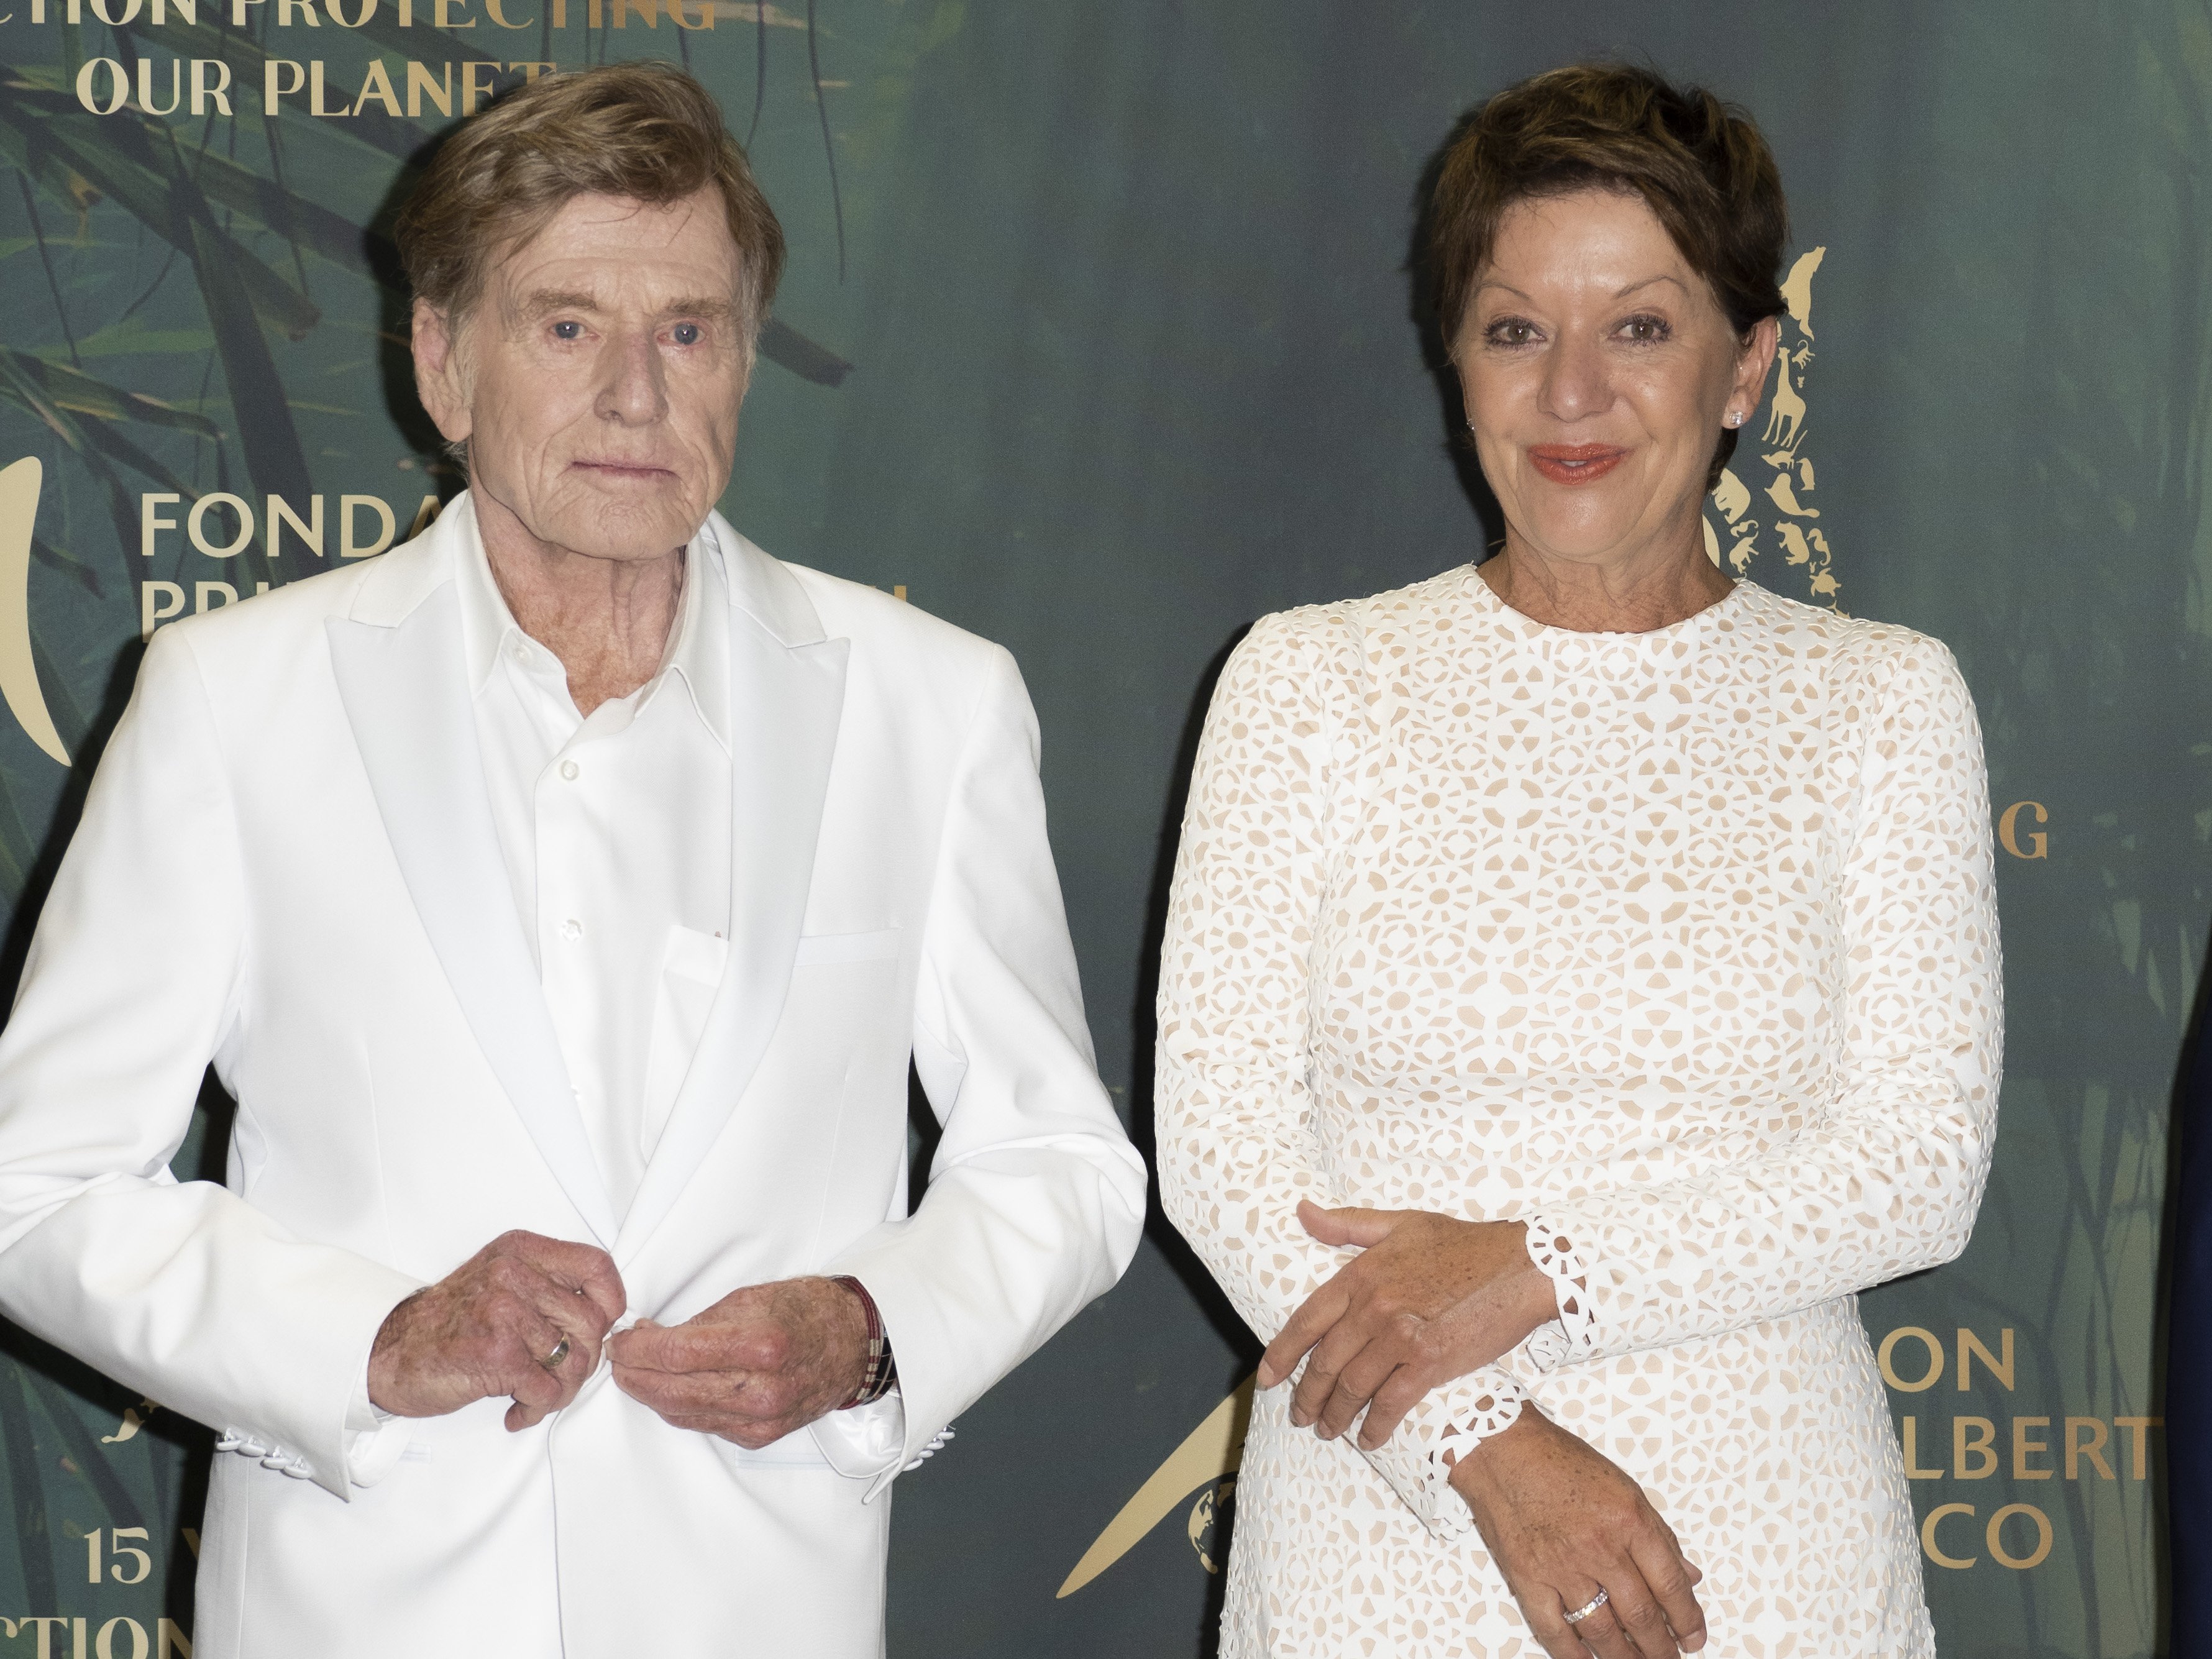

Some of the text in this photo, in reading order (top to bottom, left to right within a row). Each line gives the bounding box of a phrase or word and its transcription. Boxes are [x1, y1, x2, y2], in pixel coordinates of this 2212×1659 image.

[76, 57, 233, 116] OUR
[1999, 801, 2048, 860] G
[1877, 1327, 2015, 1392] ON
[1903, 1416, 2164, 1480] LBERT
[84, 1527, 152, 1584] 15
[1921, 1502, 2054, 1570] CO
